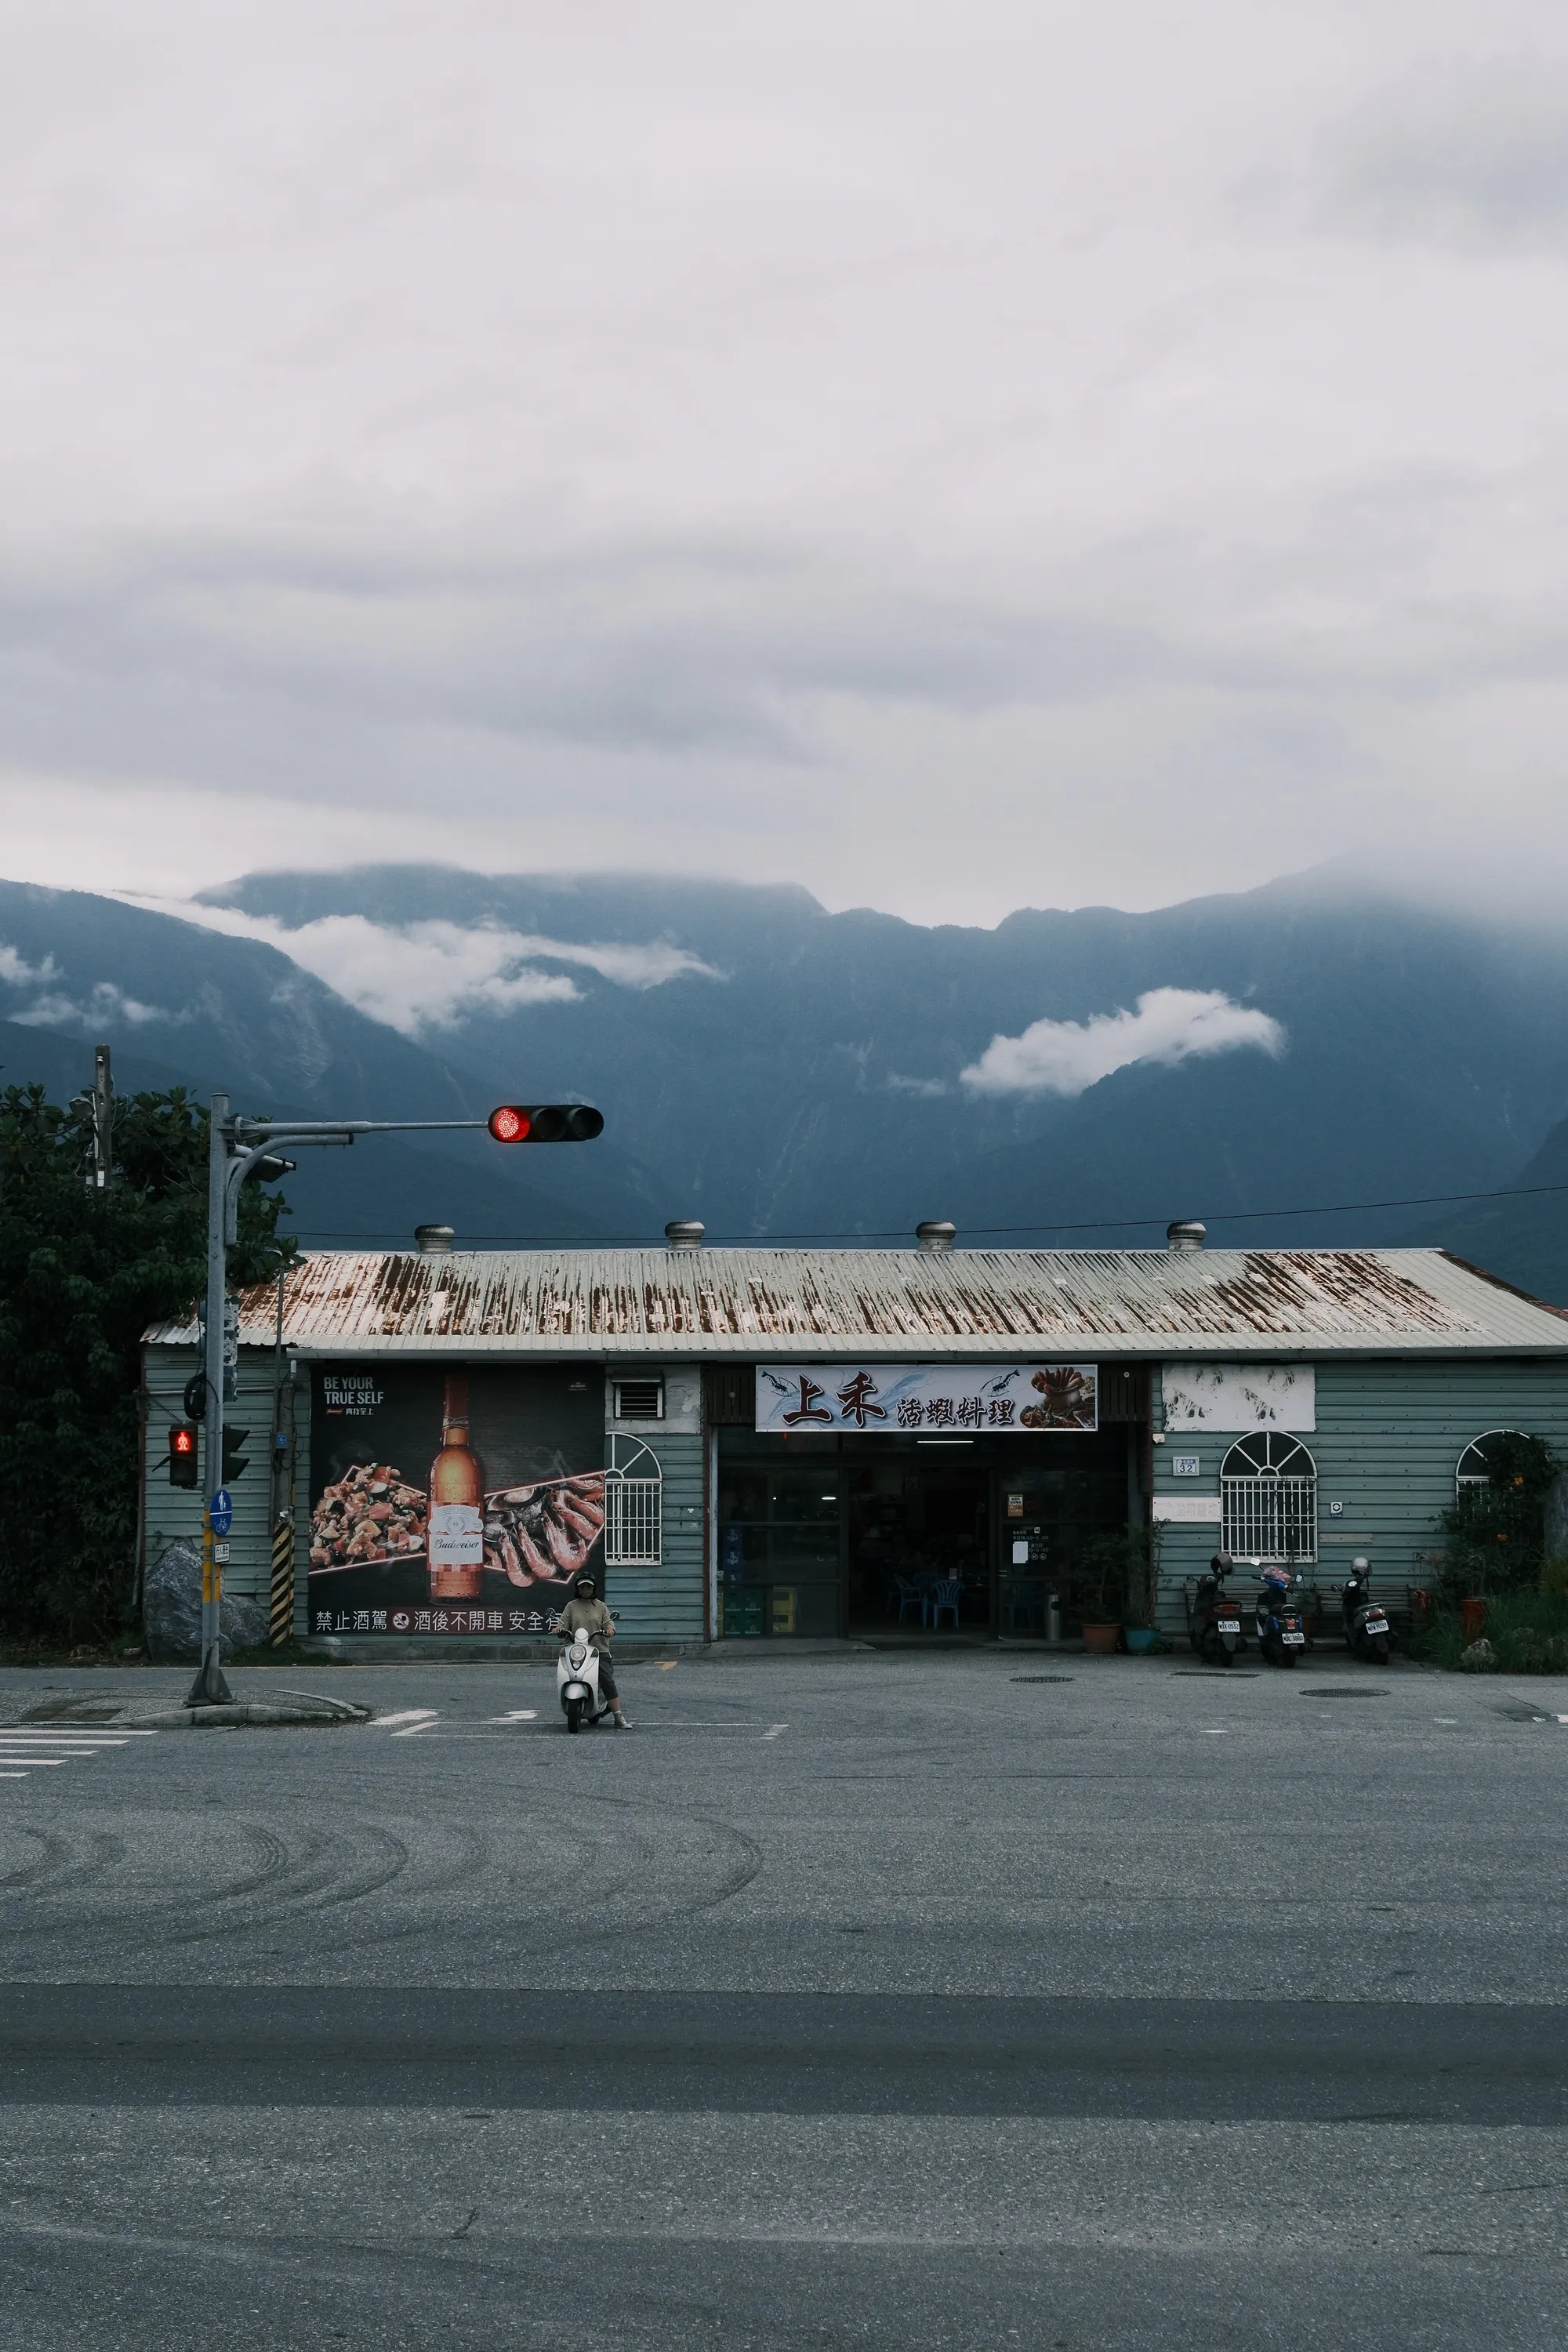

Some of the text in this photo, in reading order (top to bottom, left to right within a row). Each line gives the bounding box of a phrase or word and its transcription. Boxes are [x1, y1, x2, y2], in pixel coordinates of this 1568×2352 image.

[324, 1377, 373, 1389] BE YOUR
[325, 1392, 384, 1404] TRUE SELF
[782, 1370, 1015, 1428] 上禾 活蝦料理
[434, 1538, 480, 1549] Budweiser
[316, 1610, 387, 1632] 禁止酒駕
[414, 1610, 503, 1632] 酒後不開車
